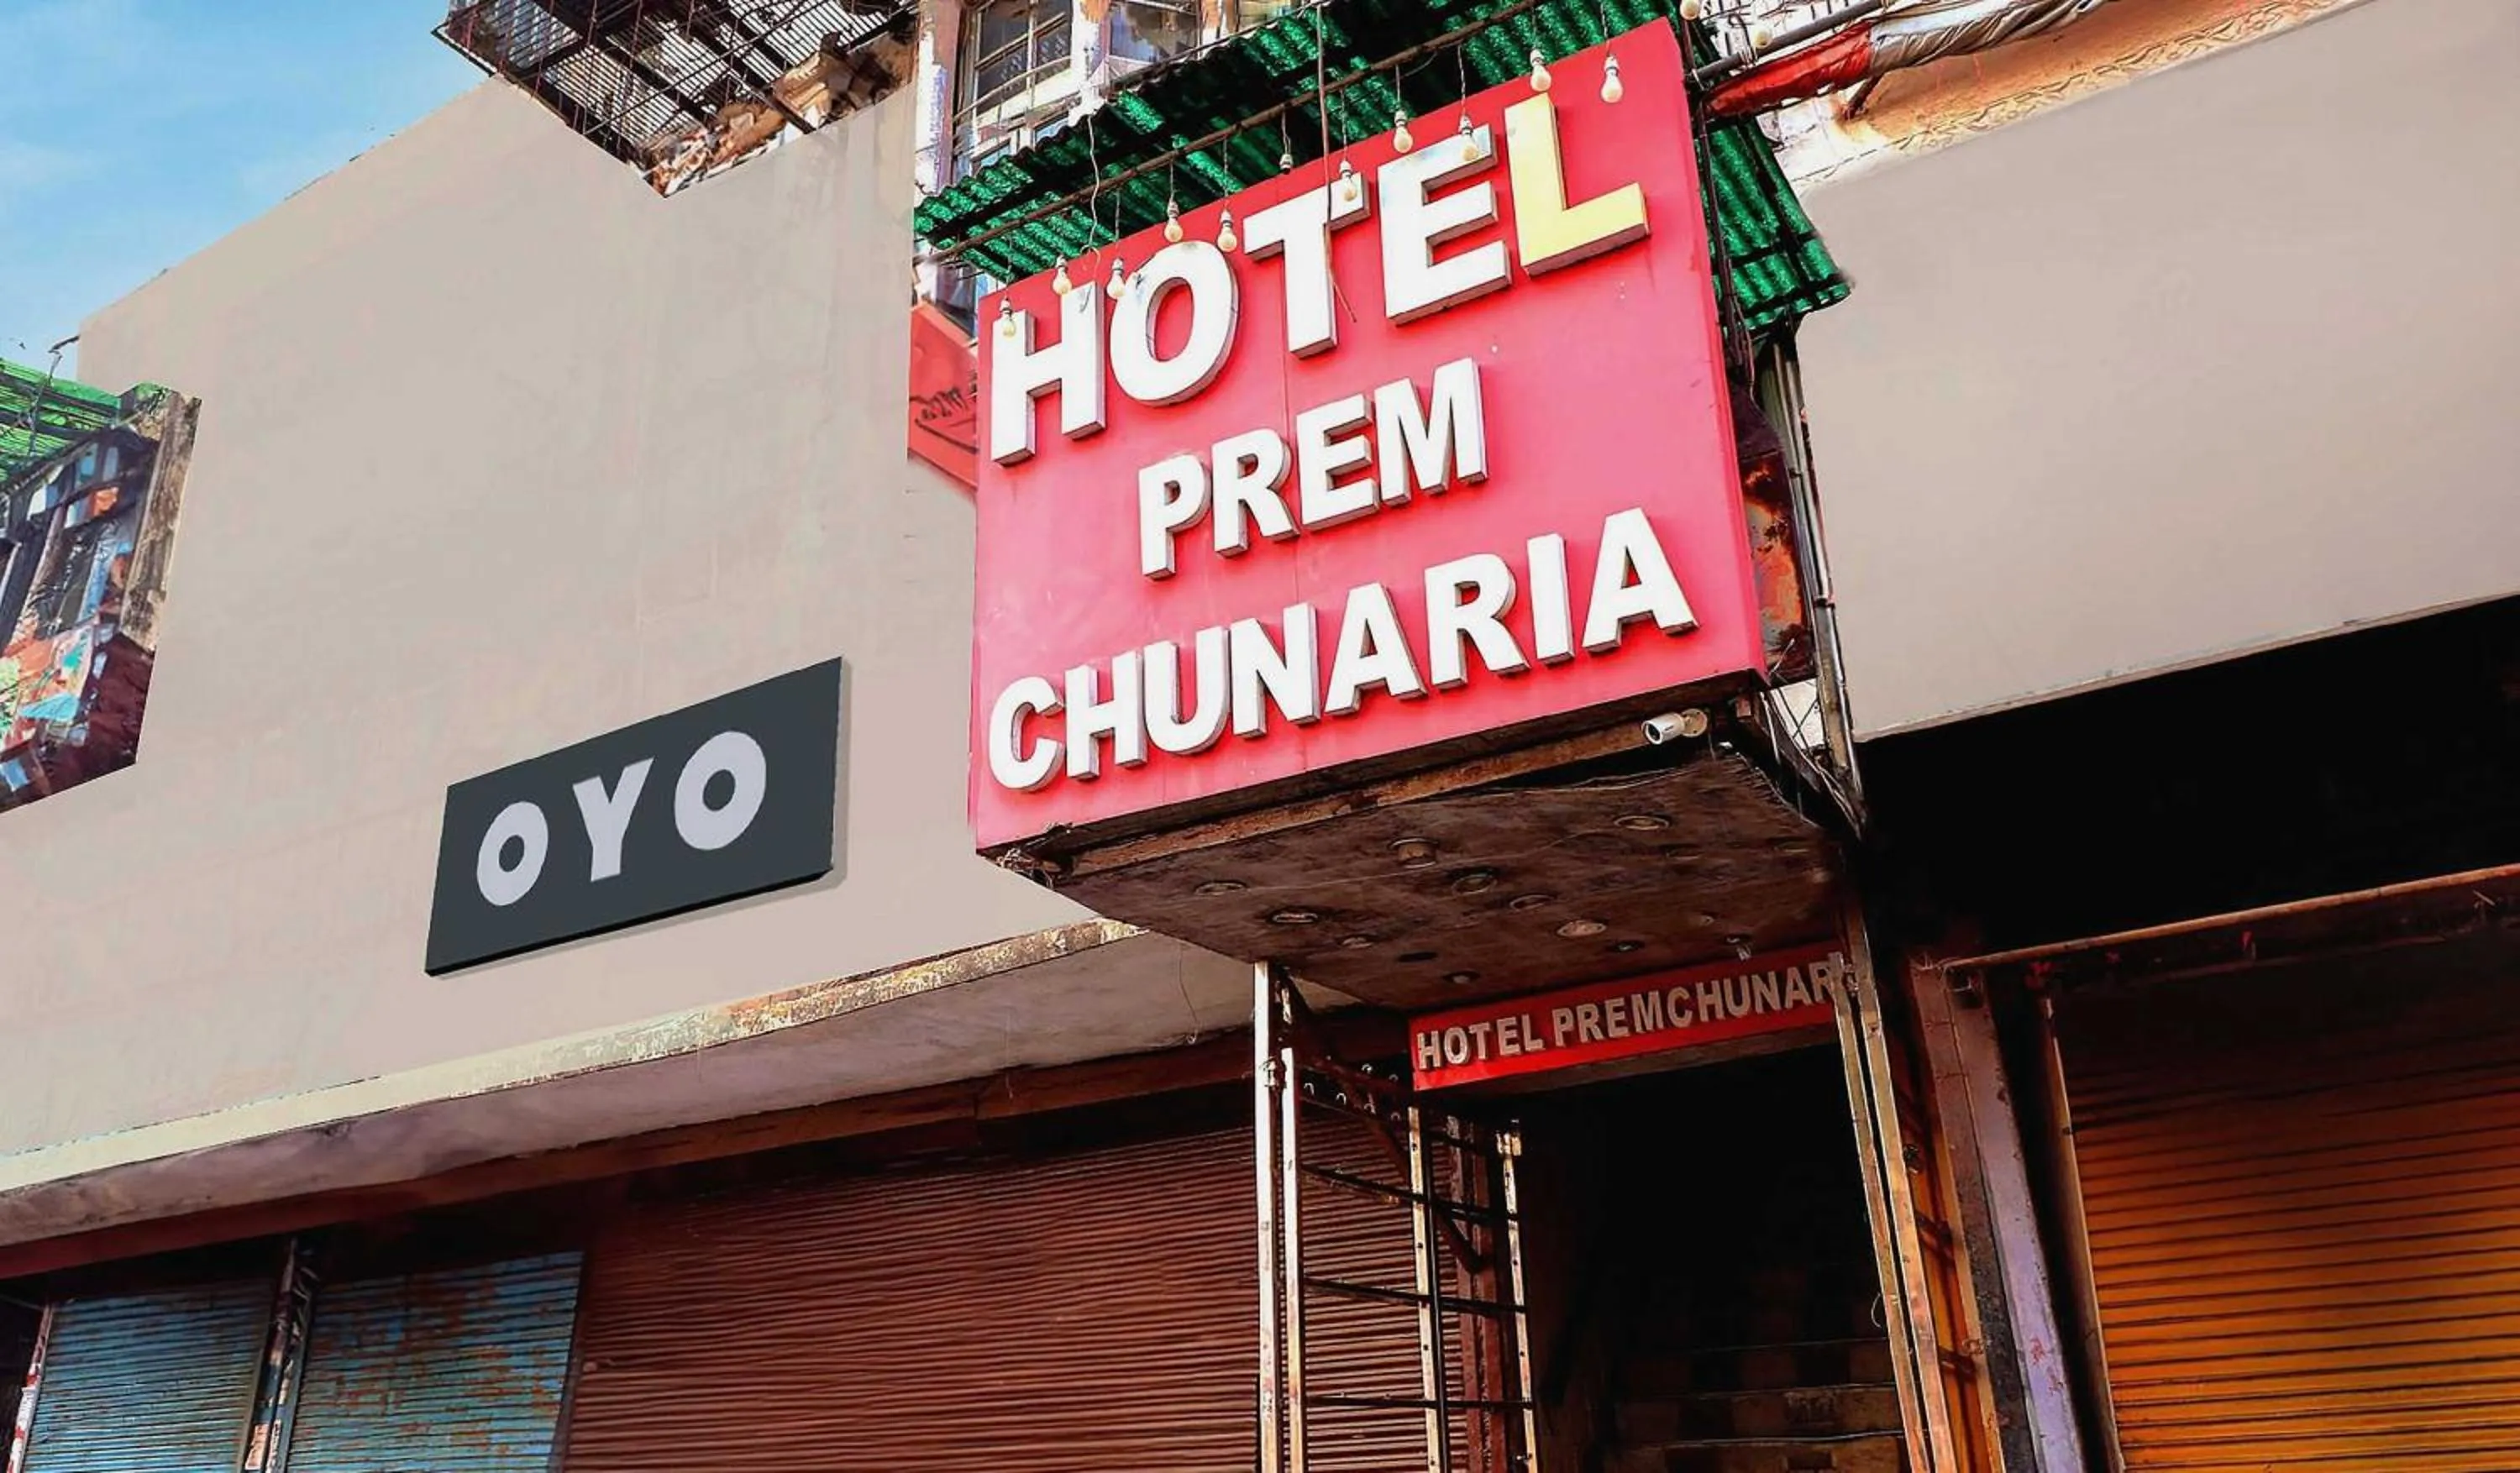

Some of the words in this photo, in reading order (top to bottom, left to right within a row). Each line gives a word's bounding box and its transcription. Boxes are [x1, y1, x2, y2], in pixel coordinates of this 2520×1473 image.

[990, 92, 1649, 467] HOTEL
[1139, 357, 1488, 580] PREM
[989, 507, 1698, 793] CHUNARIA
[476, 731, 767, 906] OYO
[1416, 1013, 1546, 1070] HOTEL
